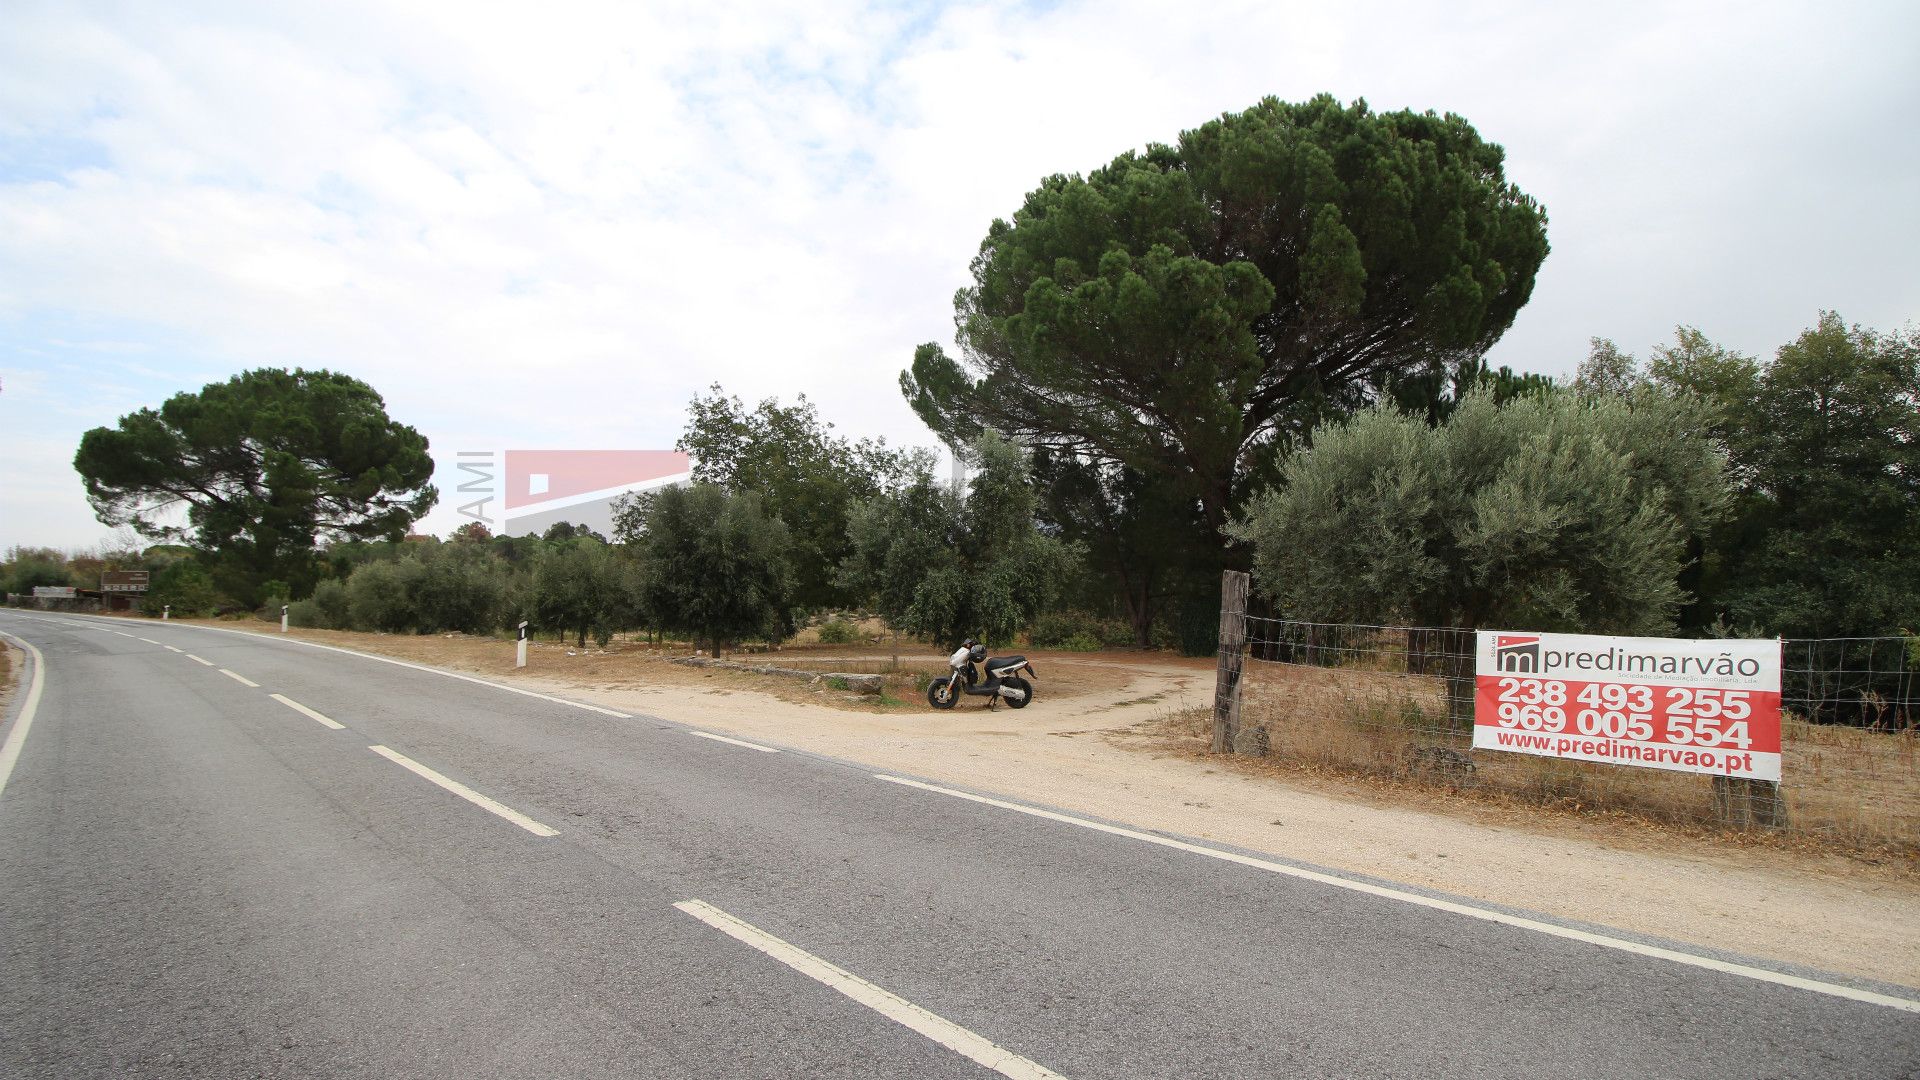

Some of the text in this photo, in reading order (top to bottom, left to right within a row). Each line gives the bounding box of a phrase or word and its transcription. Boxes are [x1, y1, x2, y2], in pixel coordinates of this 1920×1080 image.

[1544, 647, 1760, 677] predimarvão
[1617, 672, 1652, 680] Sociedade
[1664, 674, 1699, 682] Mediação
[1498, 678, 1752, 720] 238 493 255
[1498, 703, 1752, 750] 969 005 554
[1498, 732, 1752, 774] www.predimarvao.pt
